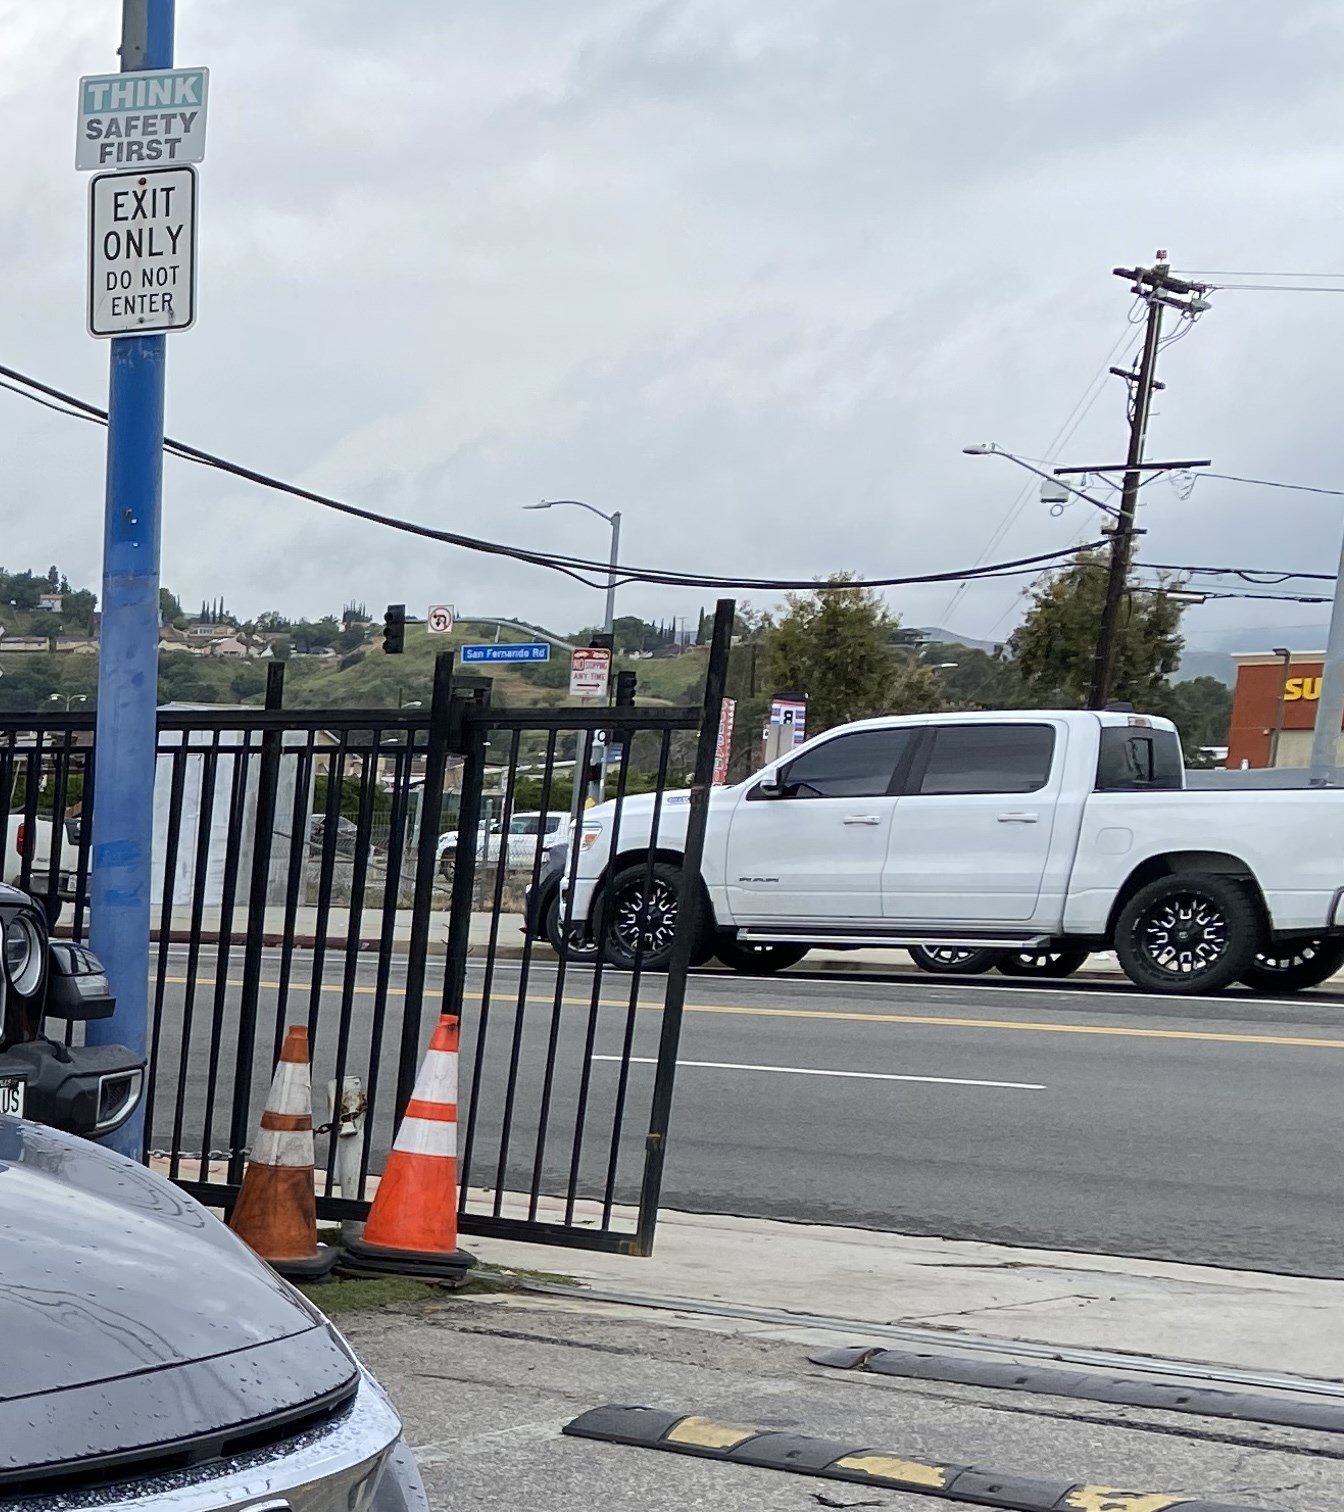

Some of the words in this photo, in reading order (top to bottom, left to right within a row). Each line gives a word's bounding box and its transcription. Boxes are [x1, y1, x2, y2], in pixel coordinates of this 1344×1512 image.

[87, 76, 201, 111] THINK
[85, 111, 198, 140] SAFETY
[99, 137, 182, 164] FIRST
[113, 186, 176, 222] EXIT
[103, 224, 184, 261] ONLY
[106, 269, 132, 291] DO
[141, 265, 180, 288] NOT
[111, 292, 173, 316] ENTER
[466, 649, 484, 659] San
[486, 648, 530, 658] Fernando
[532, 647, 546, 658] Rd
[573, 659, 584, 670] NO
[573, 673, 588, 681] ANY
[590, 673, 606, 681] TIME
